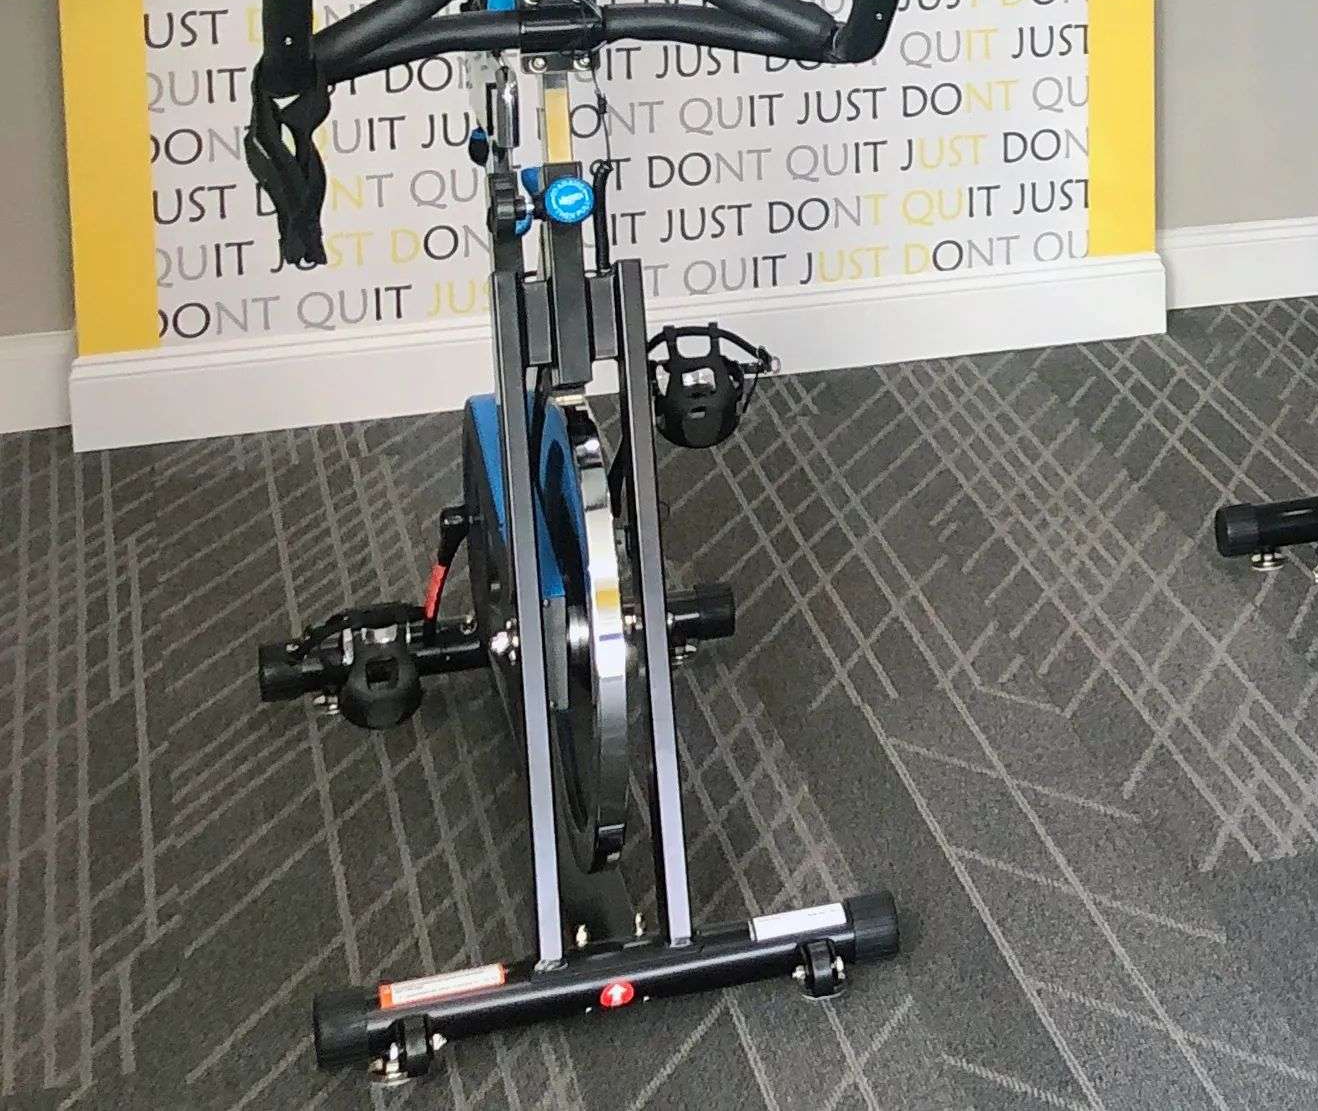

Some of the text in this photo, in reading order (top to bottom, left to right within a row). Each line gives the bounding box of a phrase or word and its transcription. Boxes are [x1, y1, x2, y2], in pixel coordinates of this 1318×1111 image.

[900, 27, 998, 69] QUIT
[679, 79, 1019, 136] QUIT JUST DONT
[647, 134, 987, 189] DONT QUIT JUST
[660, 185, 1001, 243] JUST DONT QUIT
[297, 284, 412, 332] QUIT
